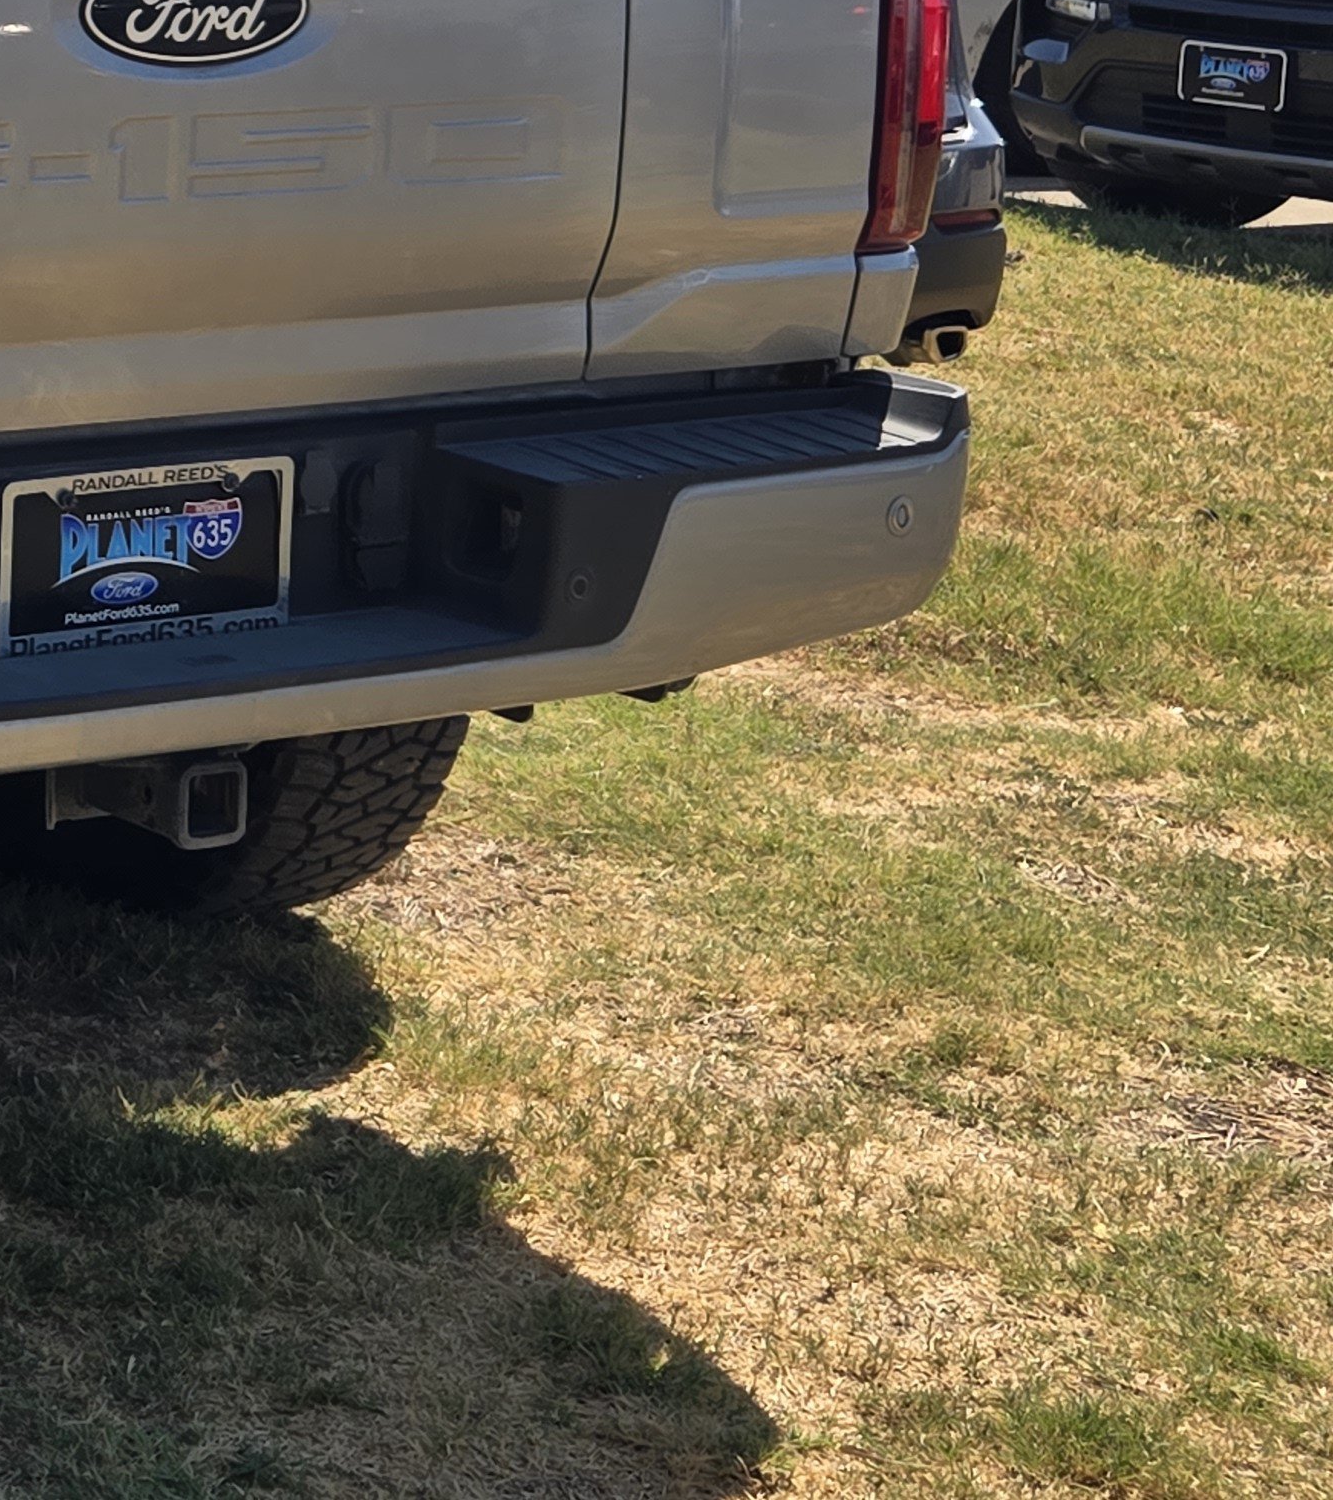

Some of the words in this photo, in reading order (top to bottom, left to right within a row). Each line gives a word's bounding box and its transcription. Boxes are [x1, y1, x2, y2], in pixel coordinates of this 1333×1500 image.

[72, 471, 158, 493] RANDALL
[164, 464, 229, 484] REED'S
[60, 512, 191, 580] PLANET
[193, 518, 233, 549] 635
[103, 576, 143, 599] Ford
[64, 602, 180, 626] PlanetFord635.com
